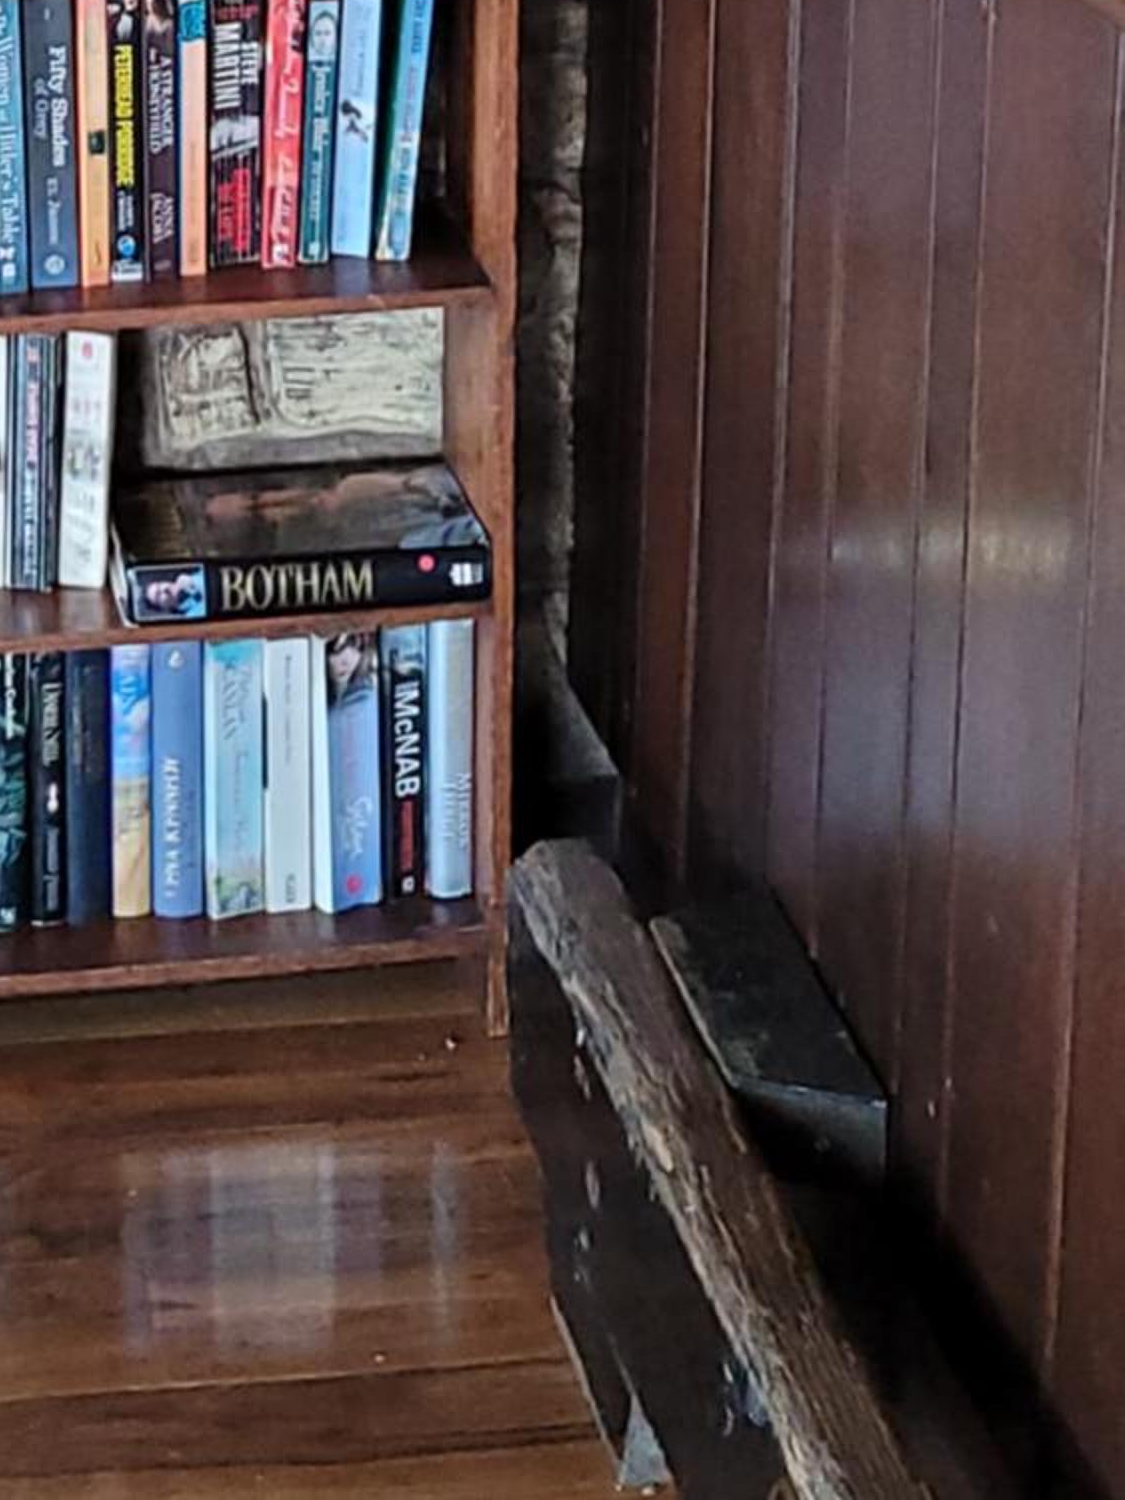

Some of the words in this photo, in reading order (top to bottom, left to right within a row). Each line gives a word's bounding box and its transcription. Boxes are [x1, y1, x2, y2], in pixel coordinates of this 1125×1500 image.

[47, 45, 68, 95] Fifty
[161, 55, 173, 67] A
[213, 23, 244, 110] MARTINI
[241, 41, 261, 84] STEVE
[34, 78, 49, 97] of
[161, 69, 174, 147] STRANGER
[31, 99, 49, 138] Grey
[52, 98, 69, 167] Shades
[1, 197, 22, 244] Table
[219, 559, 375, 613] BOTHAM
[393, 692, 421, 798] McNAB
